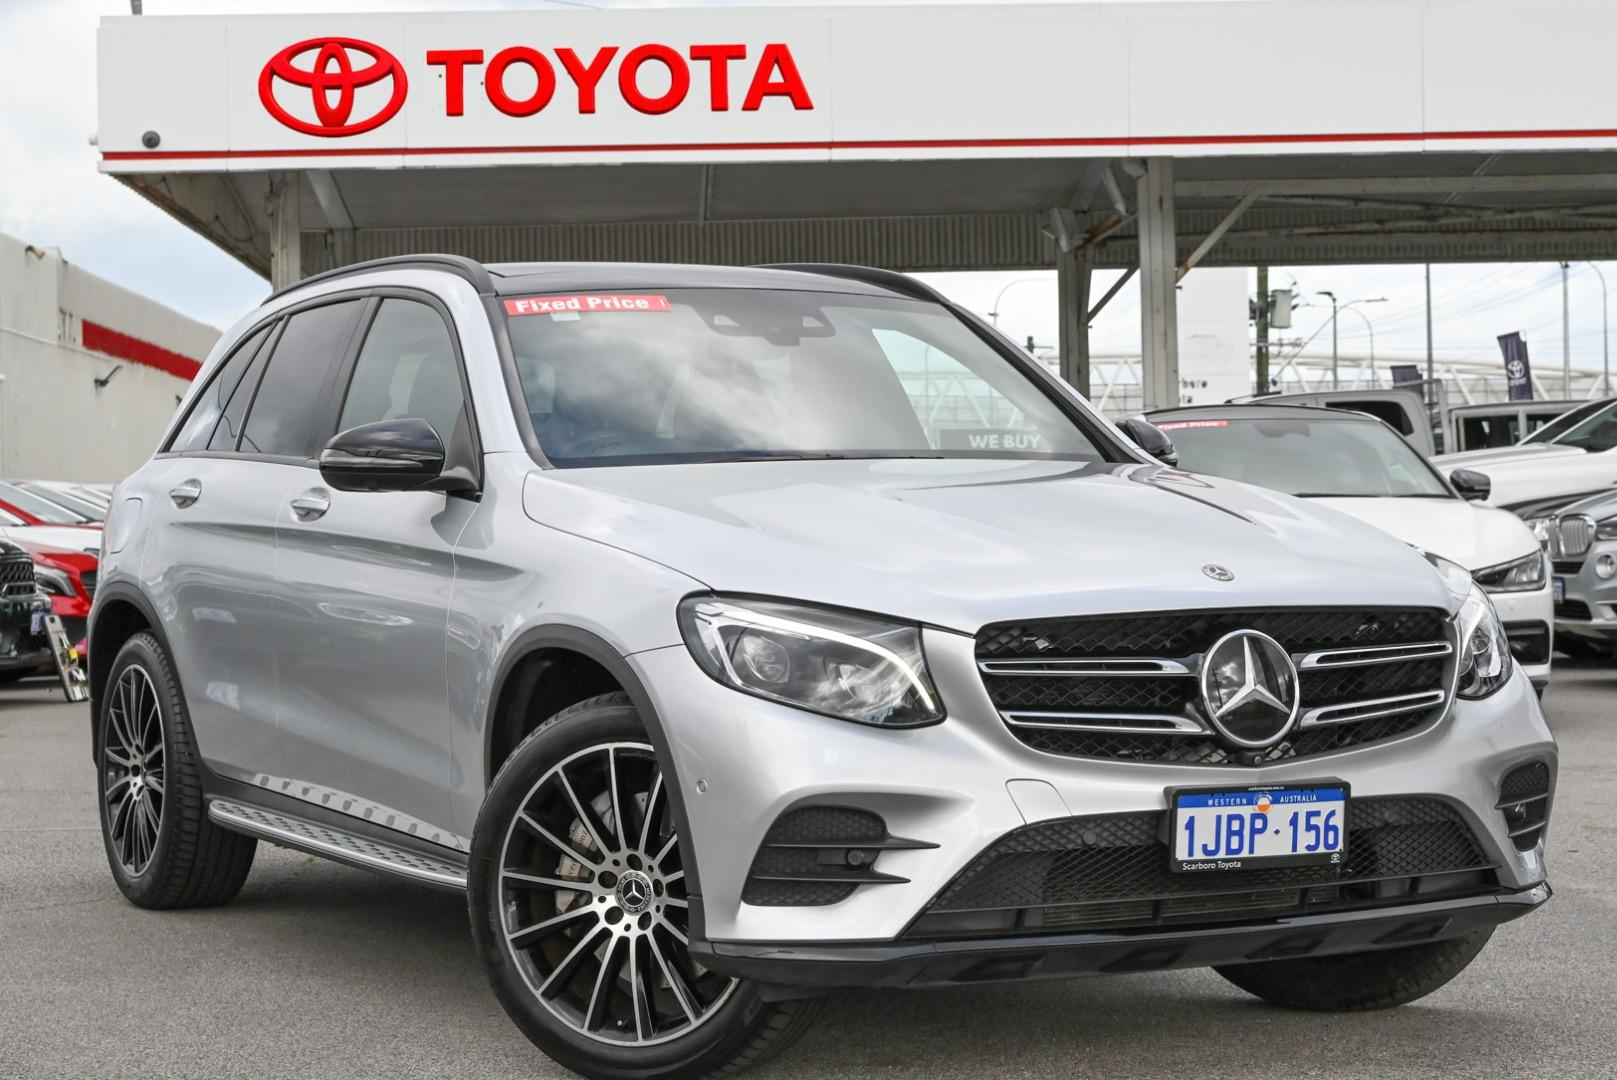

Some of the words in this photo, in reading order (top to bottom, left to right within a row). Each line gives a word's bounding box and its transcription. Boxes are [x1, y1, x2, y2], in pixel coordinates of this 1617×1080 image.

[426, 43, 814, 118] TOYOTA
[514, 298, 582, 313] Fixed
[585, 296, 650, 310] Price
[968, 434, 1000, 449] WE
[1002, 434, 1041, 449] BUY
[1207, 797, 1247, 807] WESTERN
[1279, 794, 1317, 804] AUSTRALIA
[1182, 862, 1216, 871] Scarboro
[1216, 860, 1242, 870] Toyota
